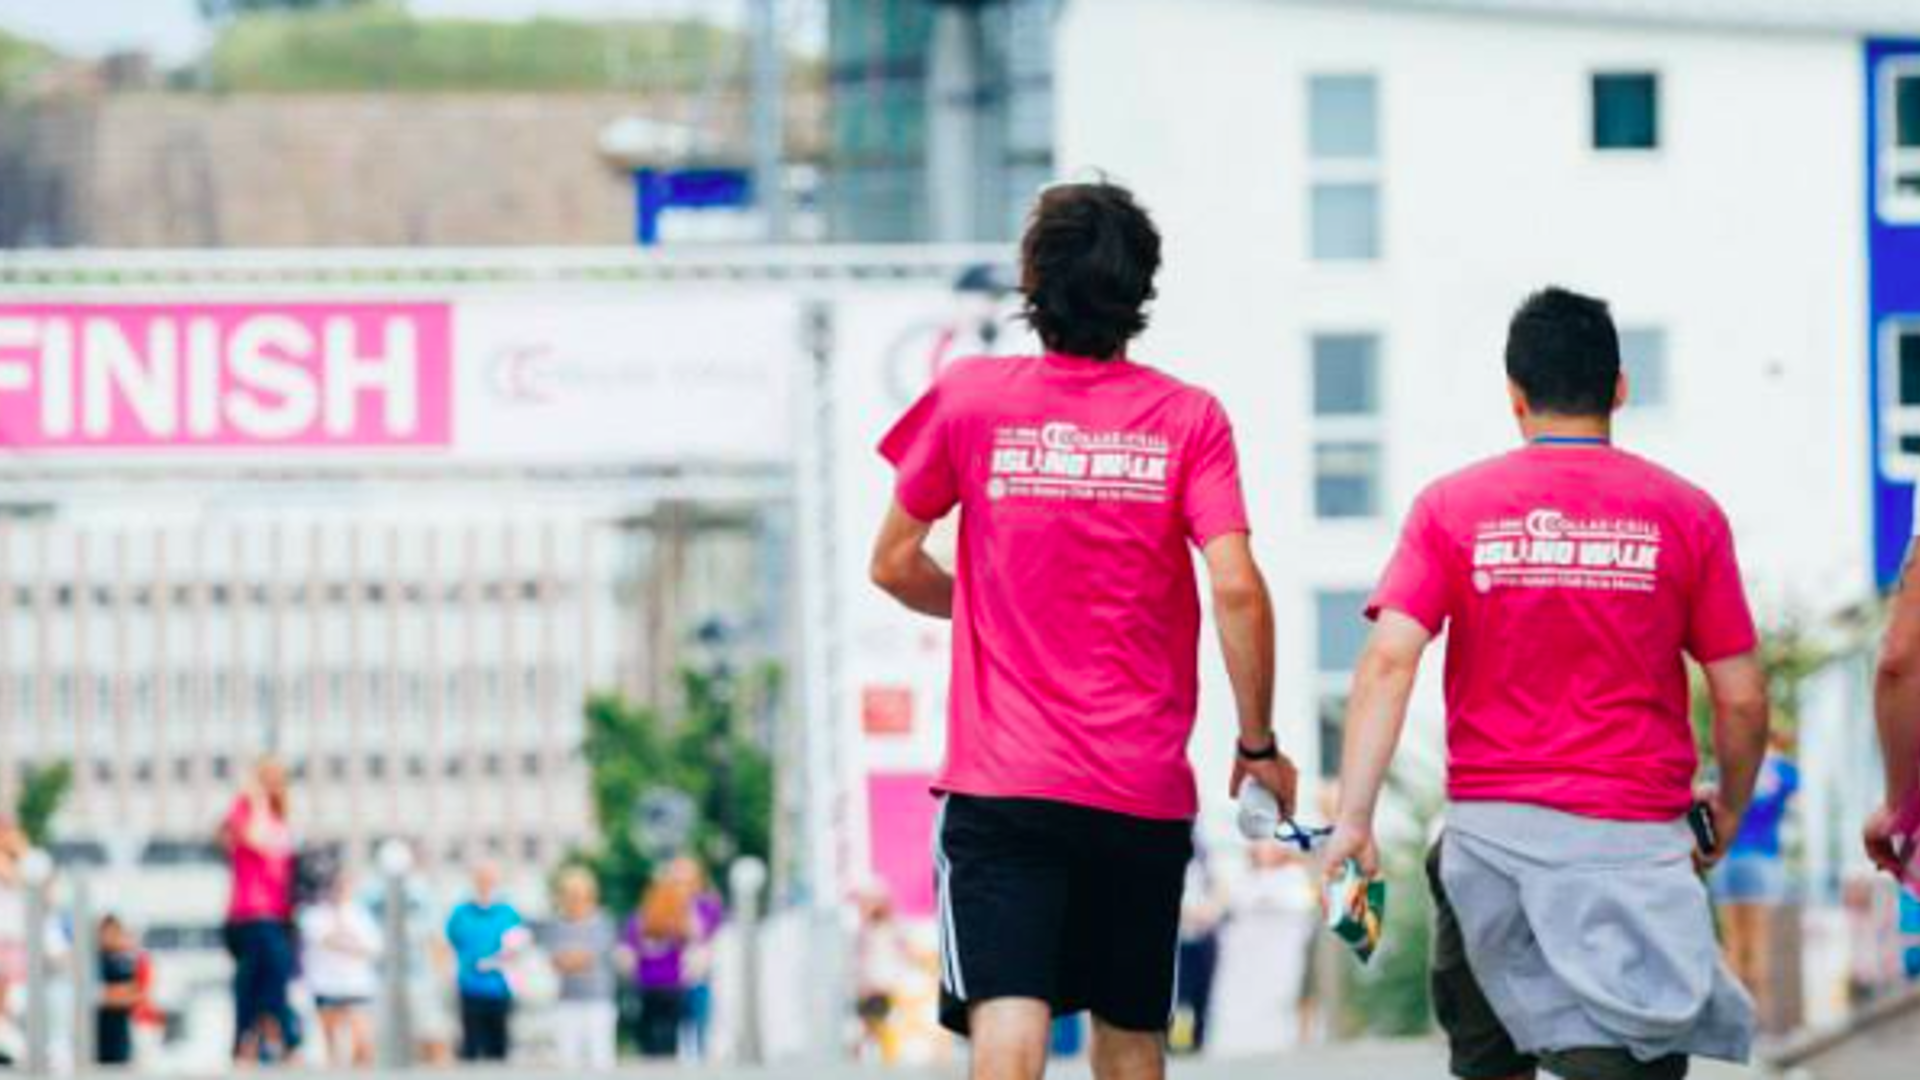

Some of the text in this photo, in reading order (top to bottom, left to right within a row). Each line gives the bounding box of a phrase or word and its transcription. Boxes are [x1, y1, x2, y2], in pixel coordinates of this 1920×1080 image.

[991, 446, 1167, 481] ISLAND WALK
[1473, 538, 1659, 570] ISLAND WALK
